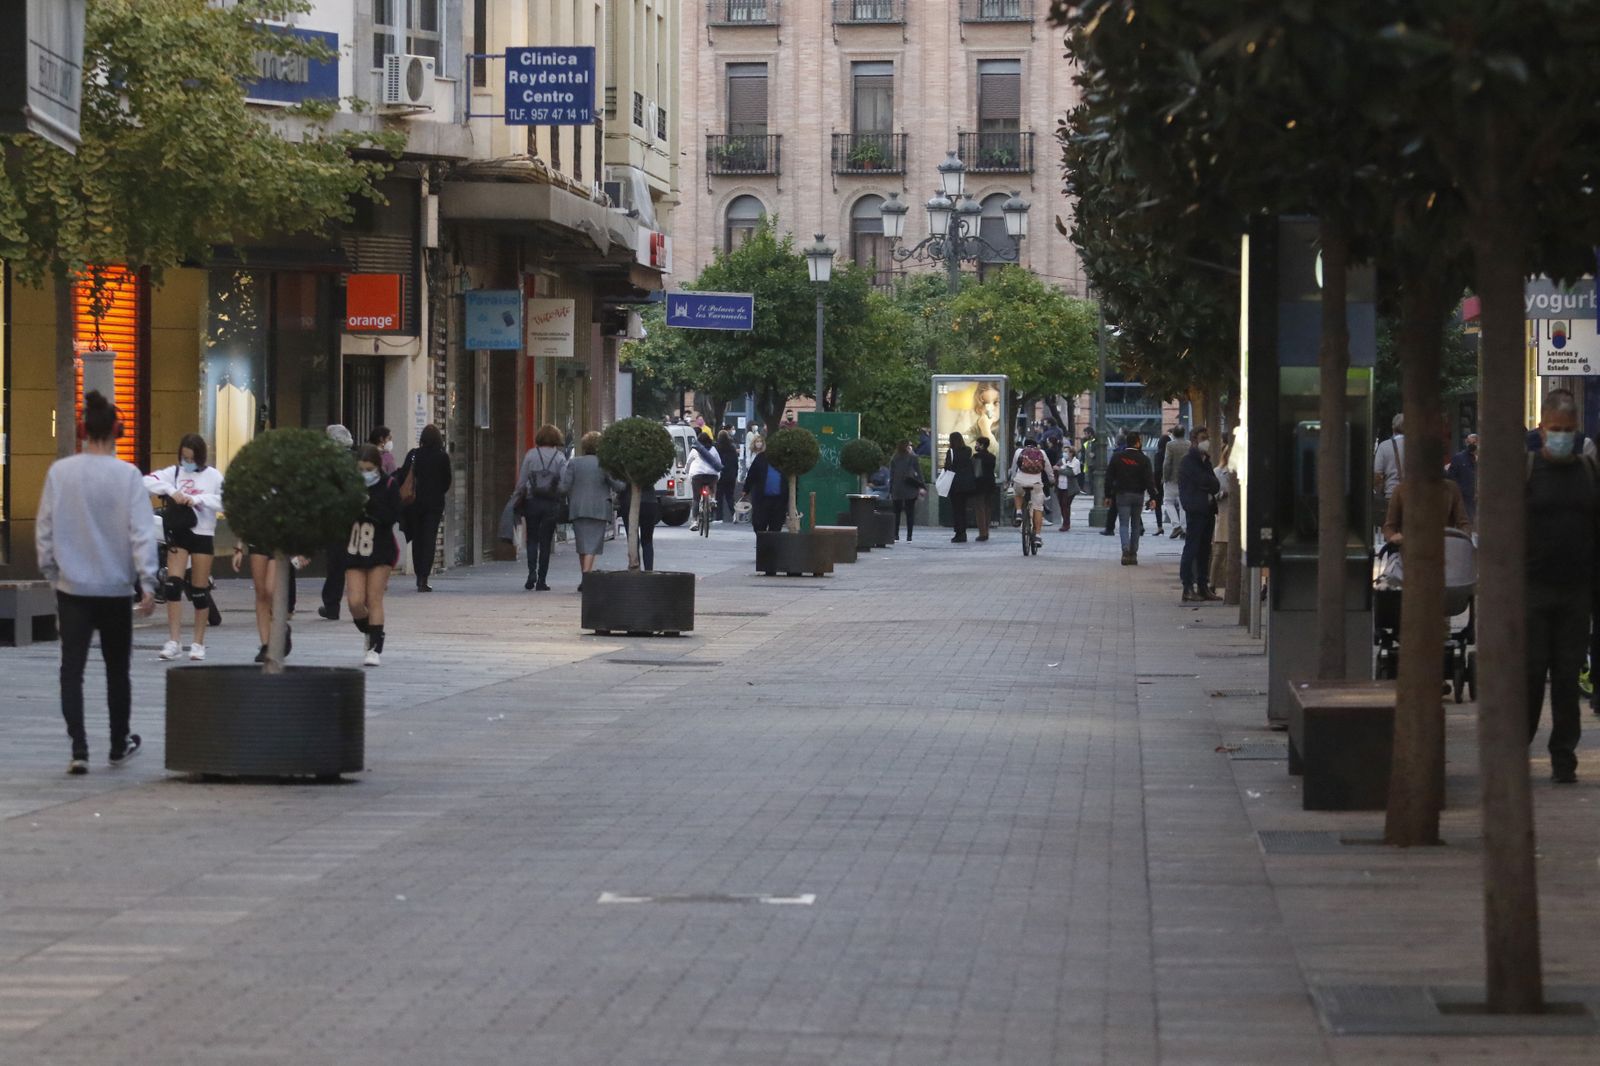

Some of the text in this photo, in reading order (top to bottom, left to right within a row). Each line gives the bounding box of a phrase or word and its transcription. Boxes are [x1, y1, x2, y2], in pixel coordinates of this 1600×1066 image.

[520, 52, 577, 65] Clinica
[509, 70, 589, 86] Reydental
[523, 90, 574, 102] Centro
[509, 108, 588, 120] TLF. 957 47 14 11
[708, 304, 735, 313] Palacio
[708, 312, 748, 320] Caramelos
[349, 316, 393, 329] orange
[1547, 357, 1577, 365] Apuestas
